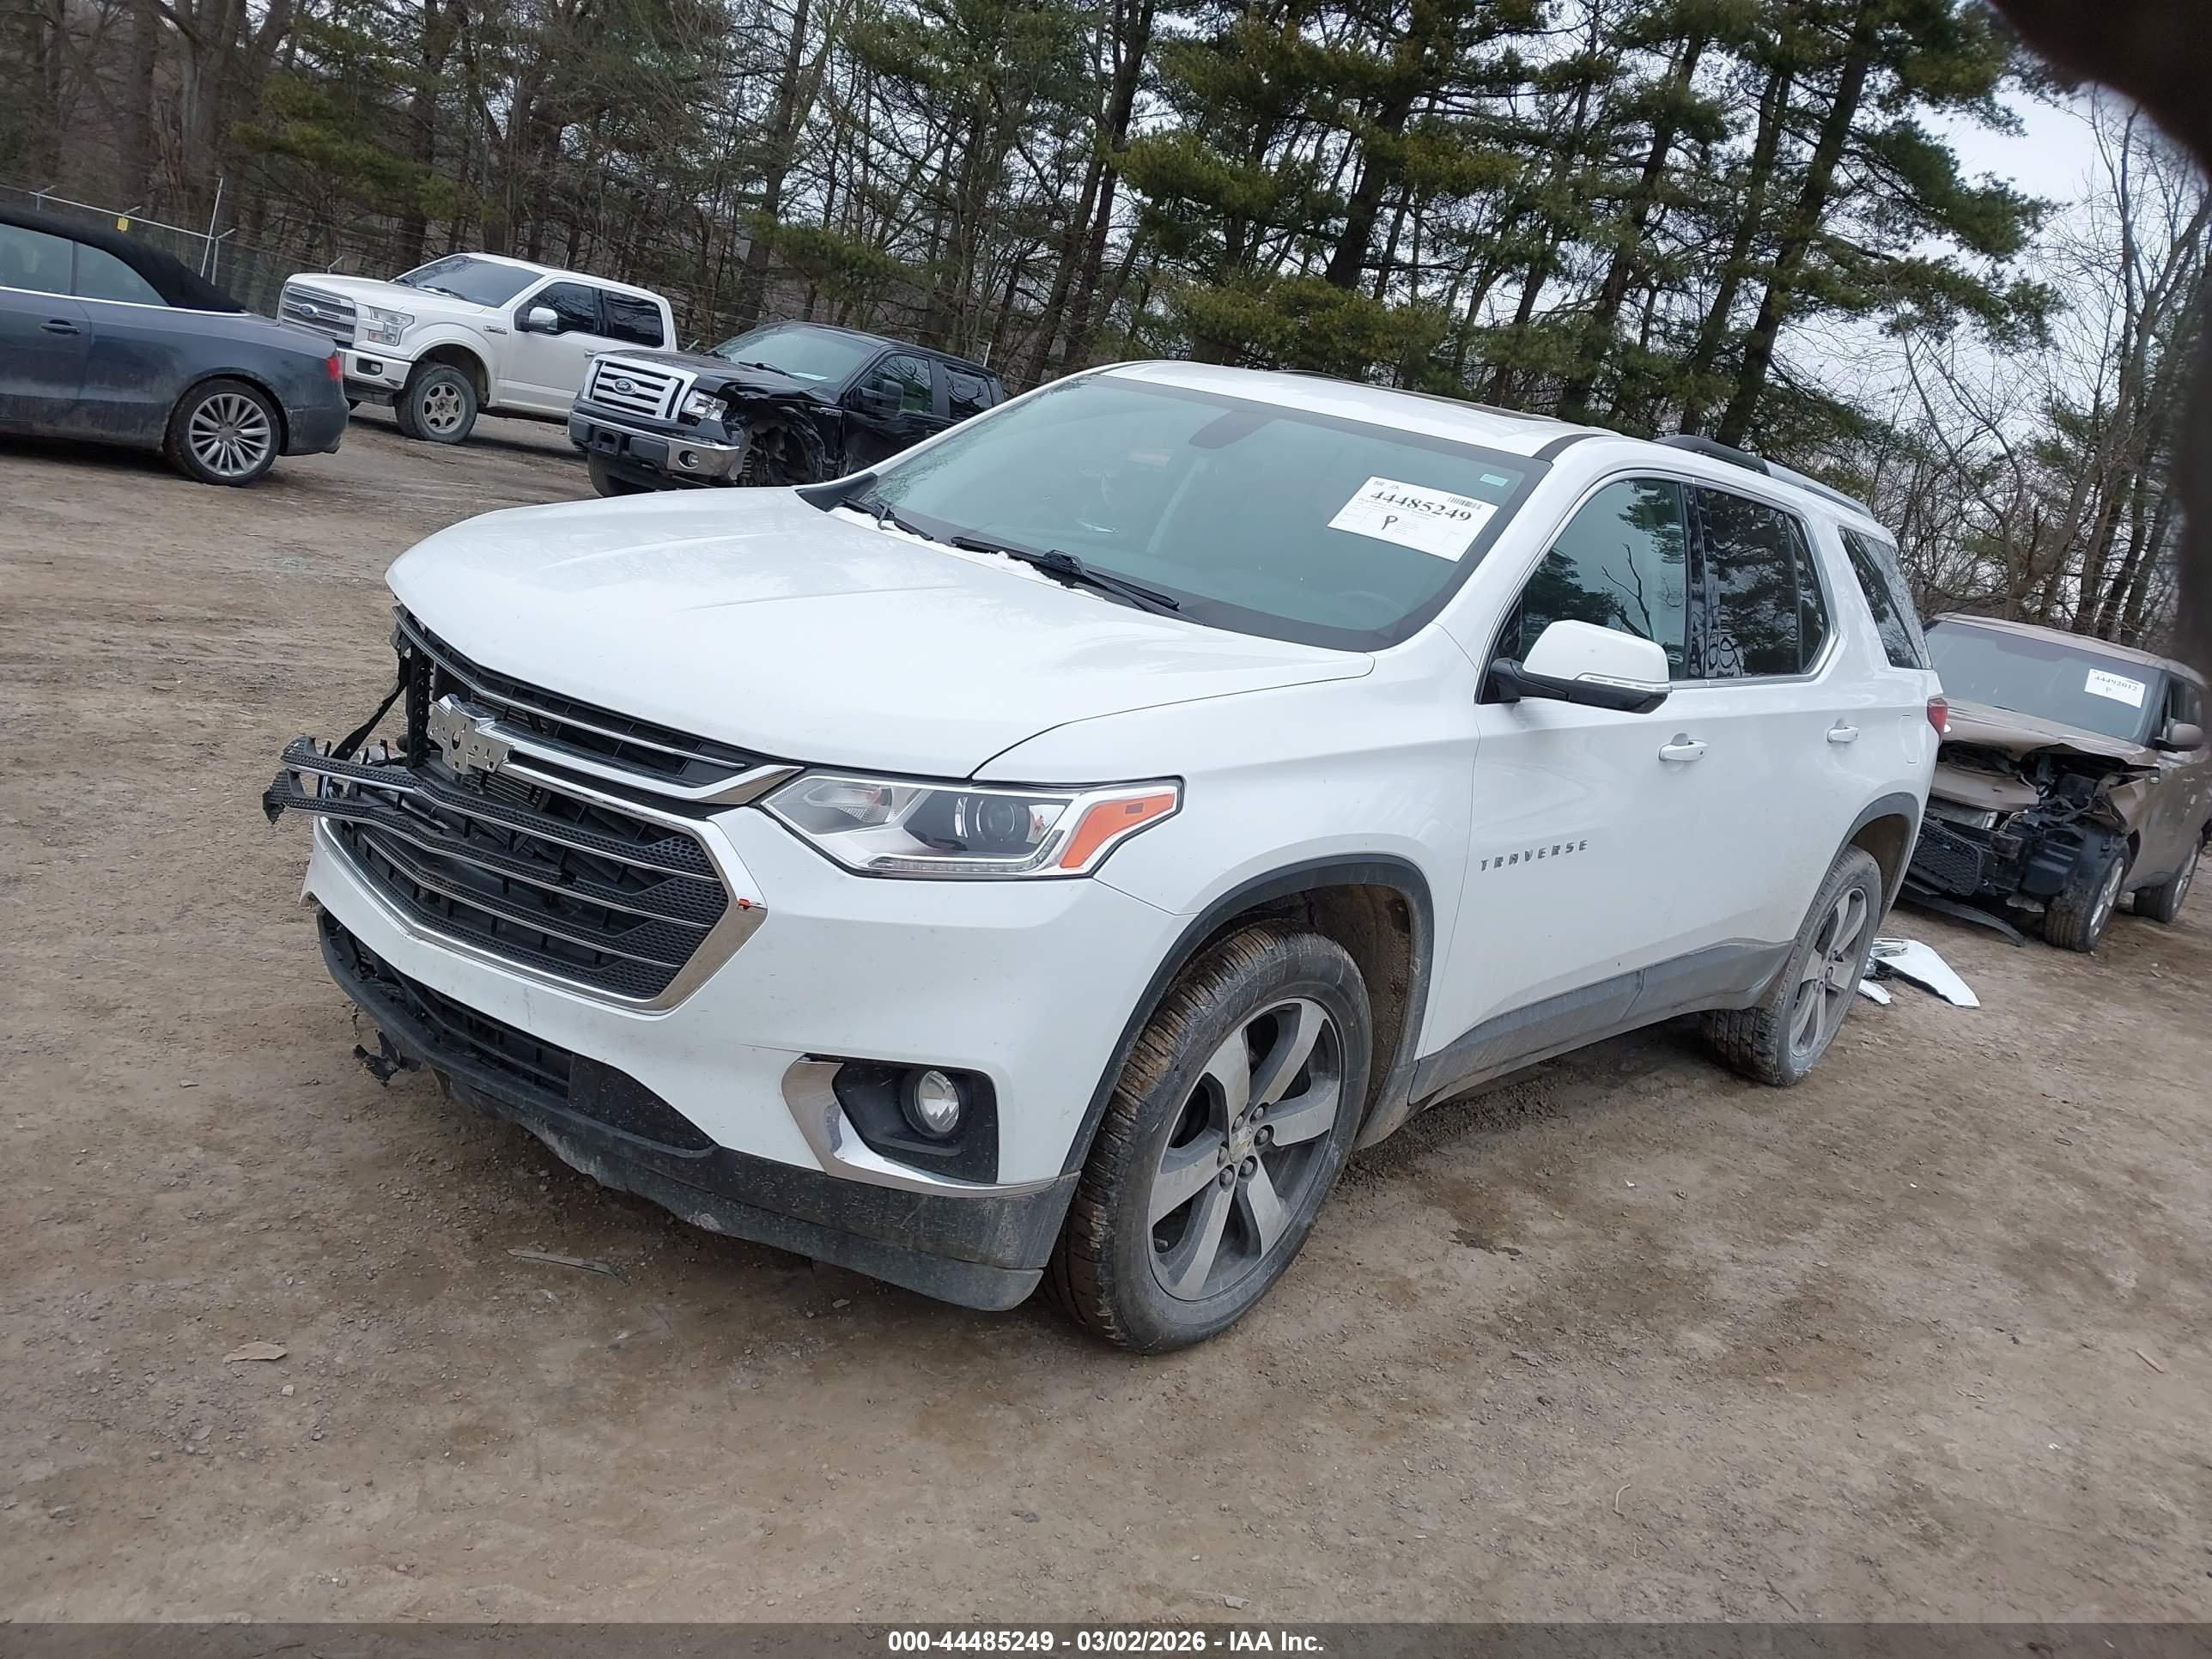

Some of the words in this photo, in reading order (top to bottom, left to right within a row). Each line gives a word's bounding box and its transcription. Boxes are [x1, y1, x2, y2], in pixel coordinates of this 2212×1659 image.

[1370, 491, 1473, 521] 44485249
[1381, 514, 1399, 530] P
[1480, 839, 1588, 872] TRAVERSE
